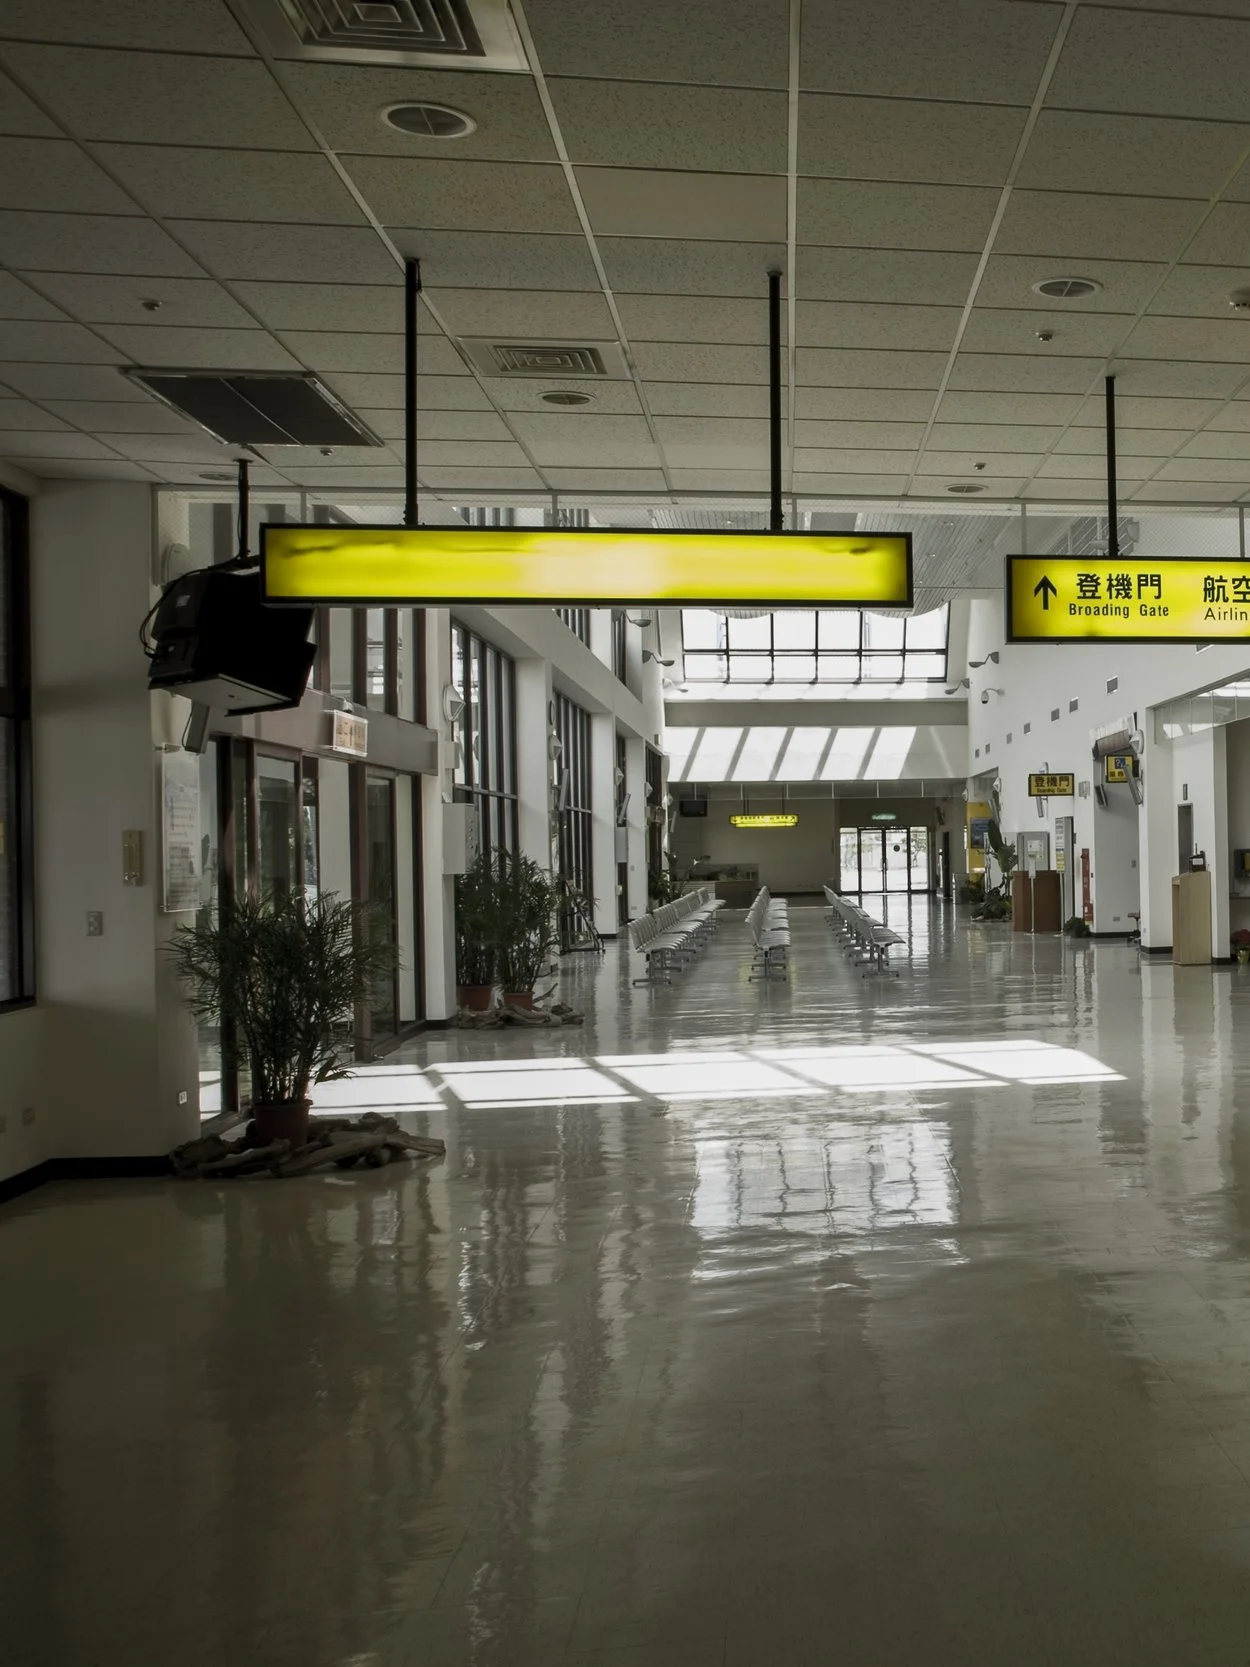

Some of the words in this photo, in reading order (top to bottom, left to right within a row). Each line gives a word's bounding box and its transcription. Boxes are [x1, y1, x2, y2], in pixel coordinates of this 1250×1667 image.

[1076, 573, 1162, 600] 登機門
[1068, 602, 1130, 619] Broading
[1139, 603, 1169, 617] Gate
[1034, 775, 1070, 788] 登機門
